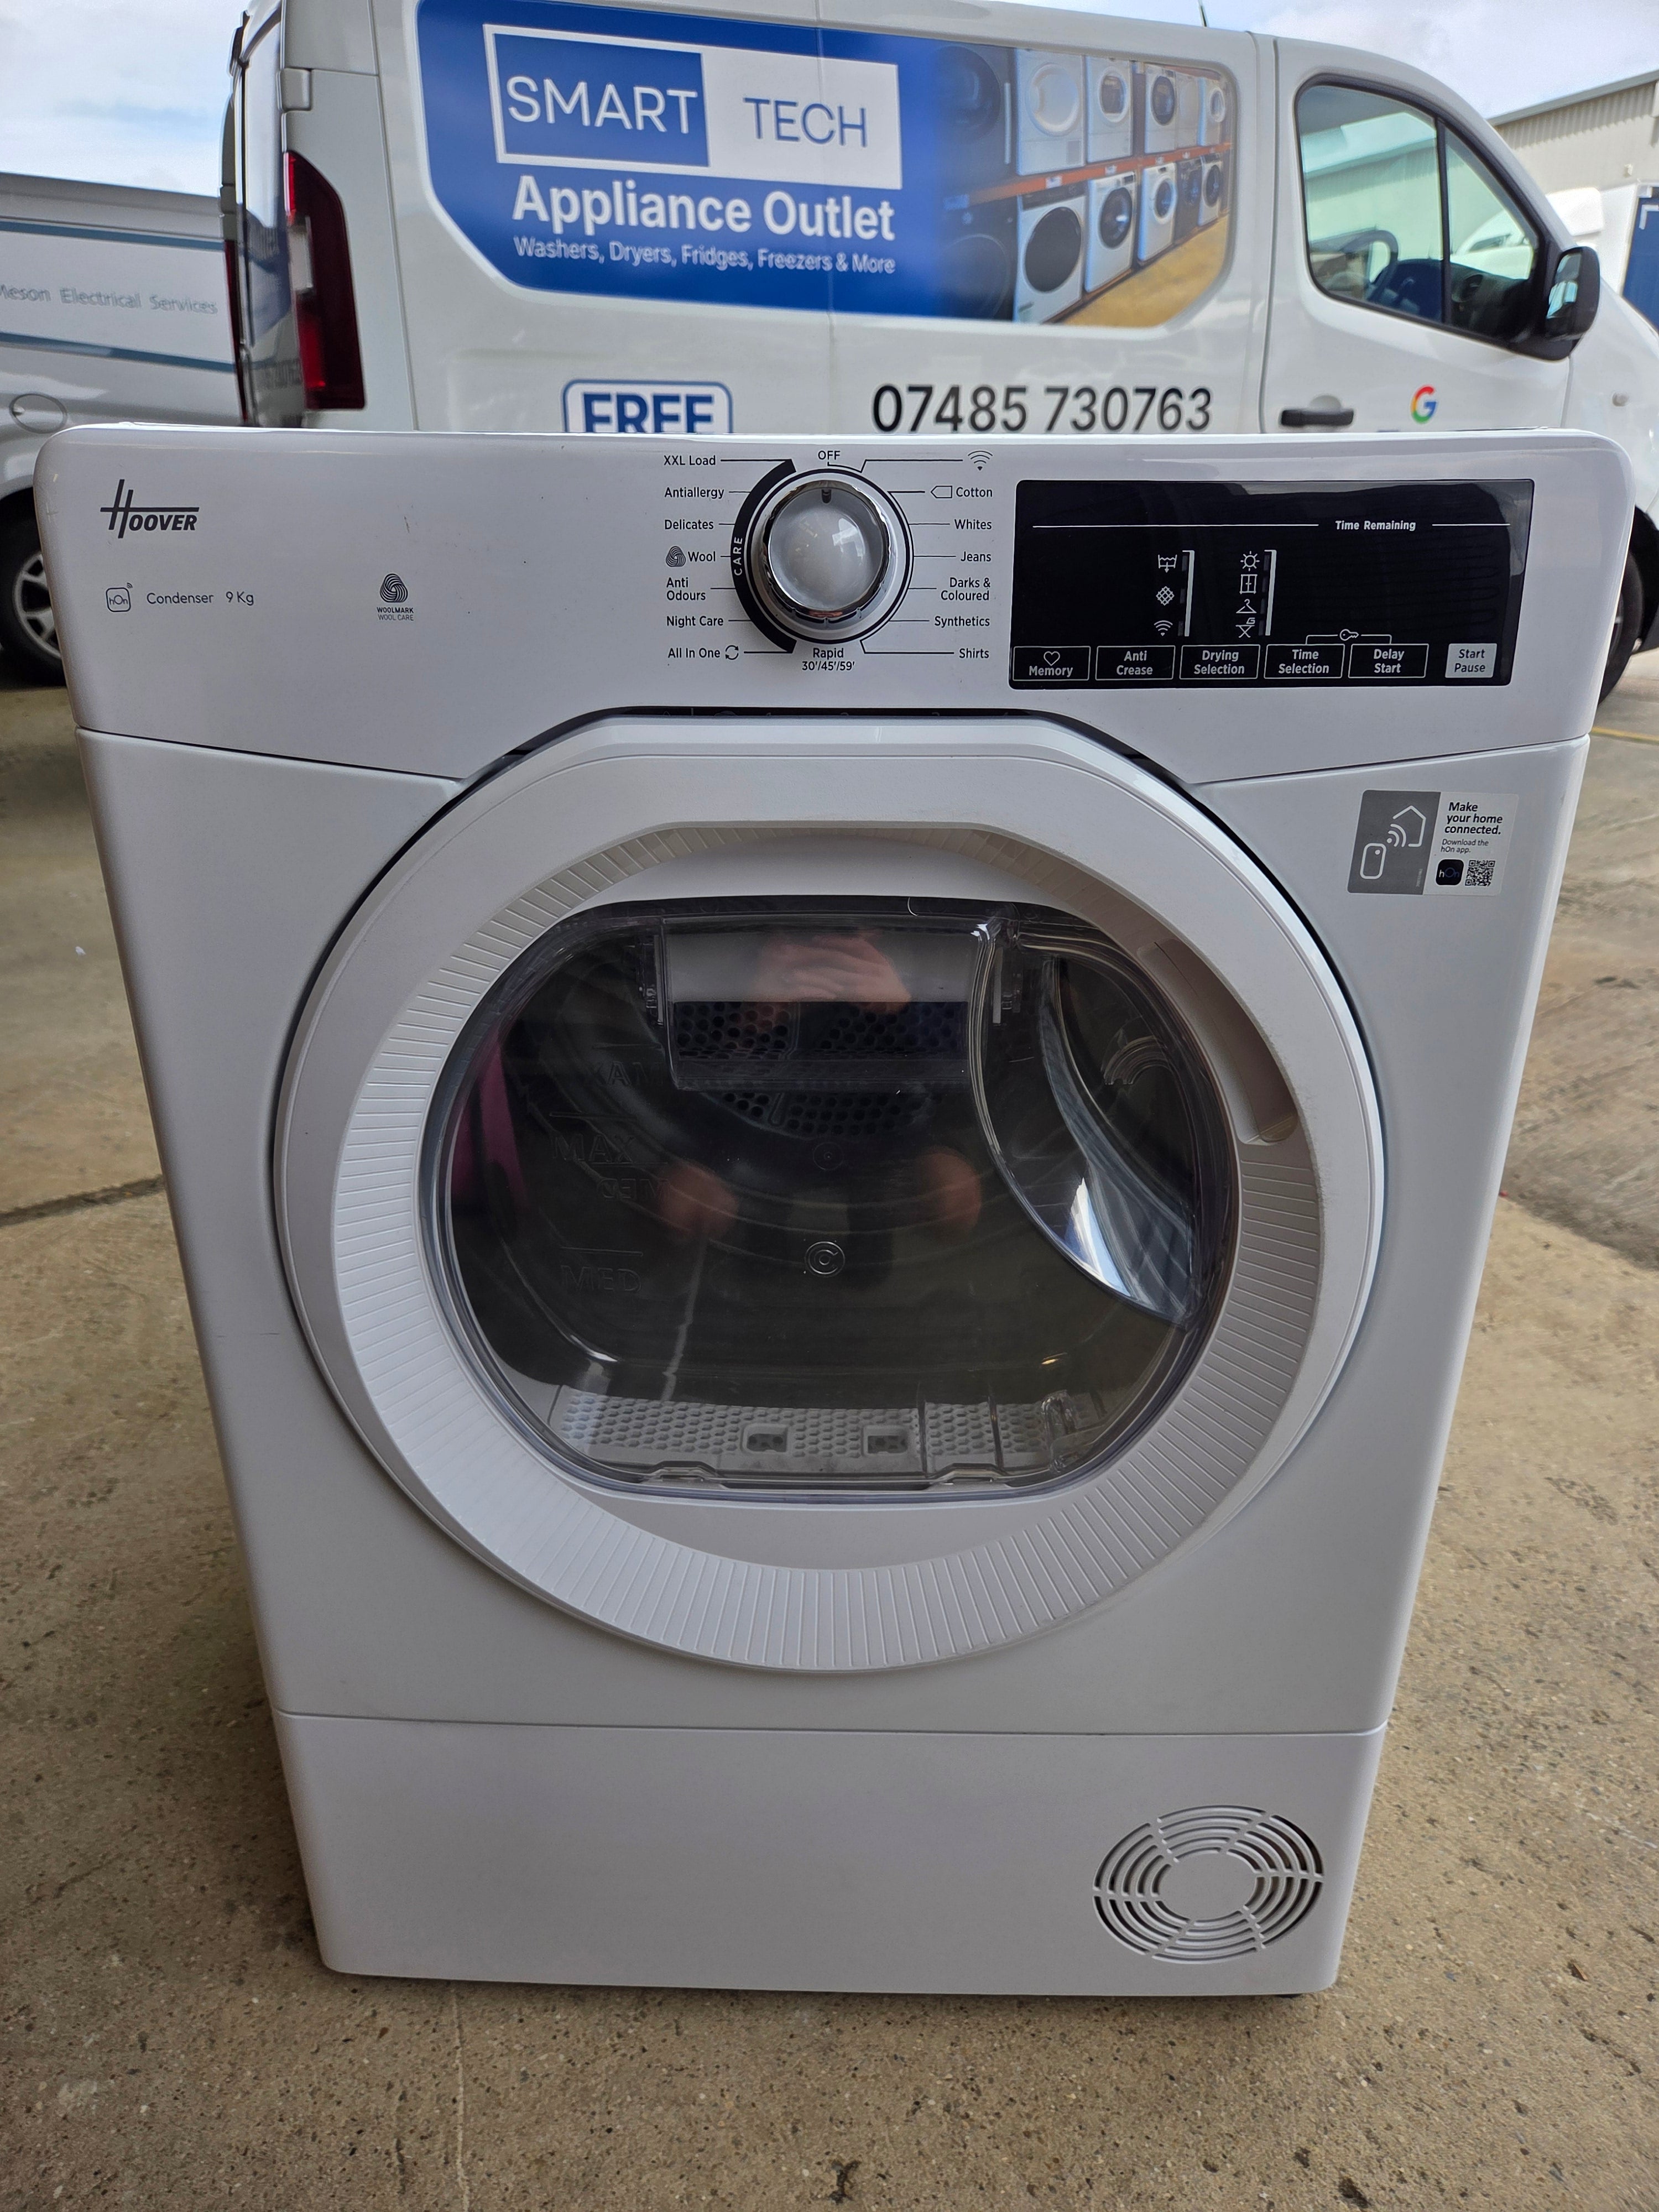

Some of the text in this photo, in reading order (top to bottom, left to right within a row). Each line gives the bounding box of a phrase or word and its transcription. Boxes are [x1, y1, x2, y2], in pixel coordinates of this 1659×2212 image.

[507, 76, 867, 147] SMART TECH
[512, 174, 896, 241] Appliance Outlet
[514, 237, 896, 274] Washers, Dryers, Fridges, Freezers & More
[60, 287, 142, 309] Electrical
[149, 294, 218, 315] Services
[873, 385, 1211, 432] 07485 730763
[1412, 387, 1437, 422] G
[664, 455, 716, 465] XXL Load
[818, 451, 840, 460] OFF
[665, 487, 724, 499] Antiallergy
[956, 487, 992, 497] Cotton
[665, 519, 713, 530] Delicates
[954, 519, 992, 529] Whites
[1335, 520, 1416, 531] Time Remaining
[687, 551, 715, 562] Wool
[733, 536, 743, 576] CARE
[961, 551, 991, 561] Jeans
[666, 577, 688, 587] Anti
[950, 577, 990, 588] Darks &
[147, 591, 254, 606] Condenser 9 Kg
[667, 590, 706, 601] Odours
[941, 590, 989, 601] Coloured
[667, 615, 723, 628] Night Care
[935, 616, 989, 628] Synthetics
[668, 648, 720, 658] All In One
[813, 648, 844, 659] Rapid
[959, 648, 989, 658] Shirts
[1124, 650, 1147, 661] Anti
[1202, 650, 1239, 662] Drying
[1292, 649, 1318, 659] Time
[1374, 649, 1404, 661] Delay
[1459, 649, 1485, 658] Start
[1029, 665, 1073, 677] Memory
[1117, 665, 1152, 675] Crease
[1194, 664, 1245, 674] Selection
[1279, 663, 1329, 674] Selection
[1374, 663, 1401, 673] Start
[1454, 663, 1485, 672] Pause
[1449, 802, 1478, 812] Make
[1447, 813, 1503, 824] your home
[1445, 825, 1500, 834] connected.
